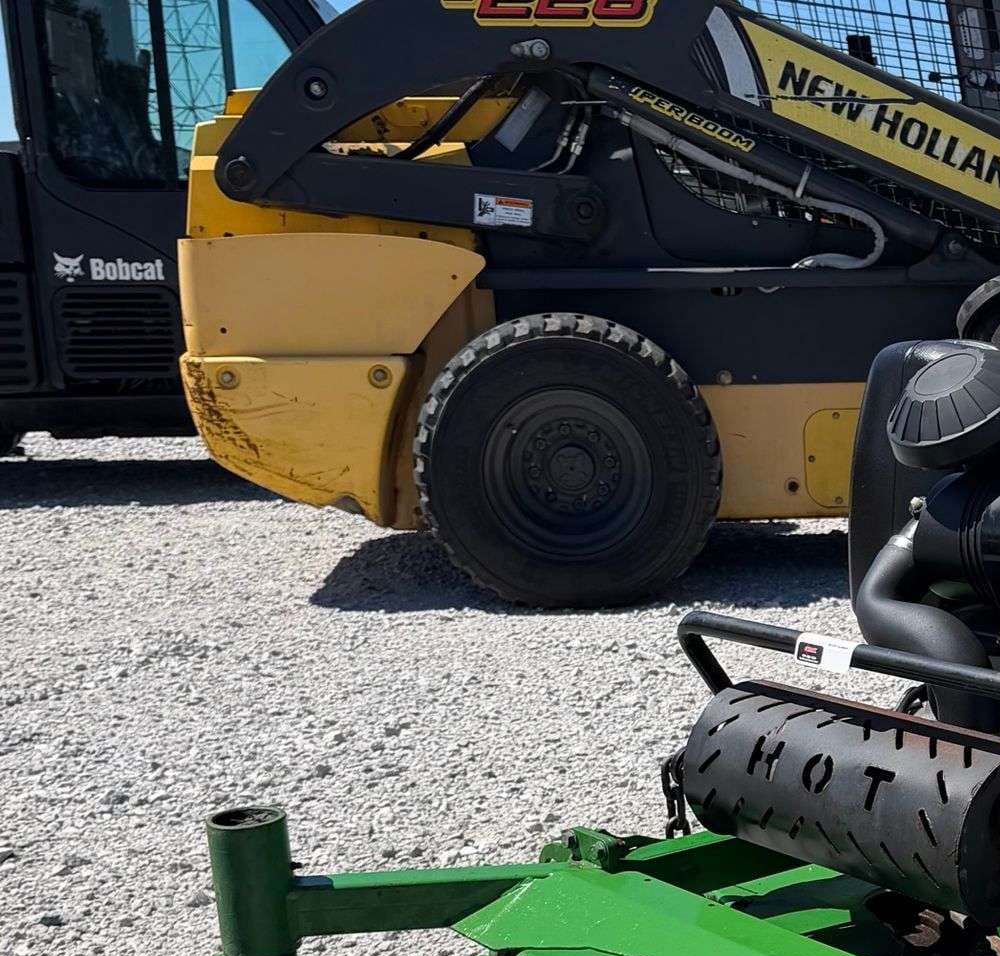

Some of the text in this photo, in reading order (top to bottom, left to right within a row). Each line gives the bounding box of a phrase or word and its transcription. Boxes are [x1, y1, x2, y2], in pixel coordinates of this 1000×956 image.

[777, 60, 869, 122] NEW
[684, 112, 756, 152] BOOM
[89, 258, 165, 281] Bobcat
[746, 734, 897, 812] HOT
